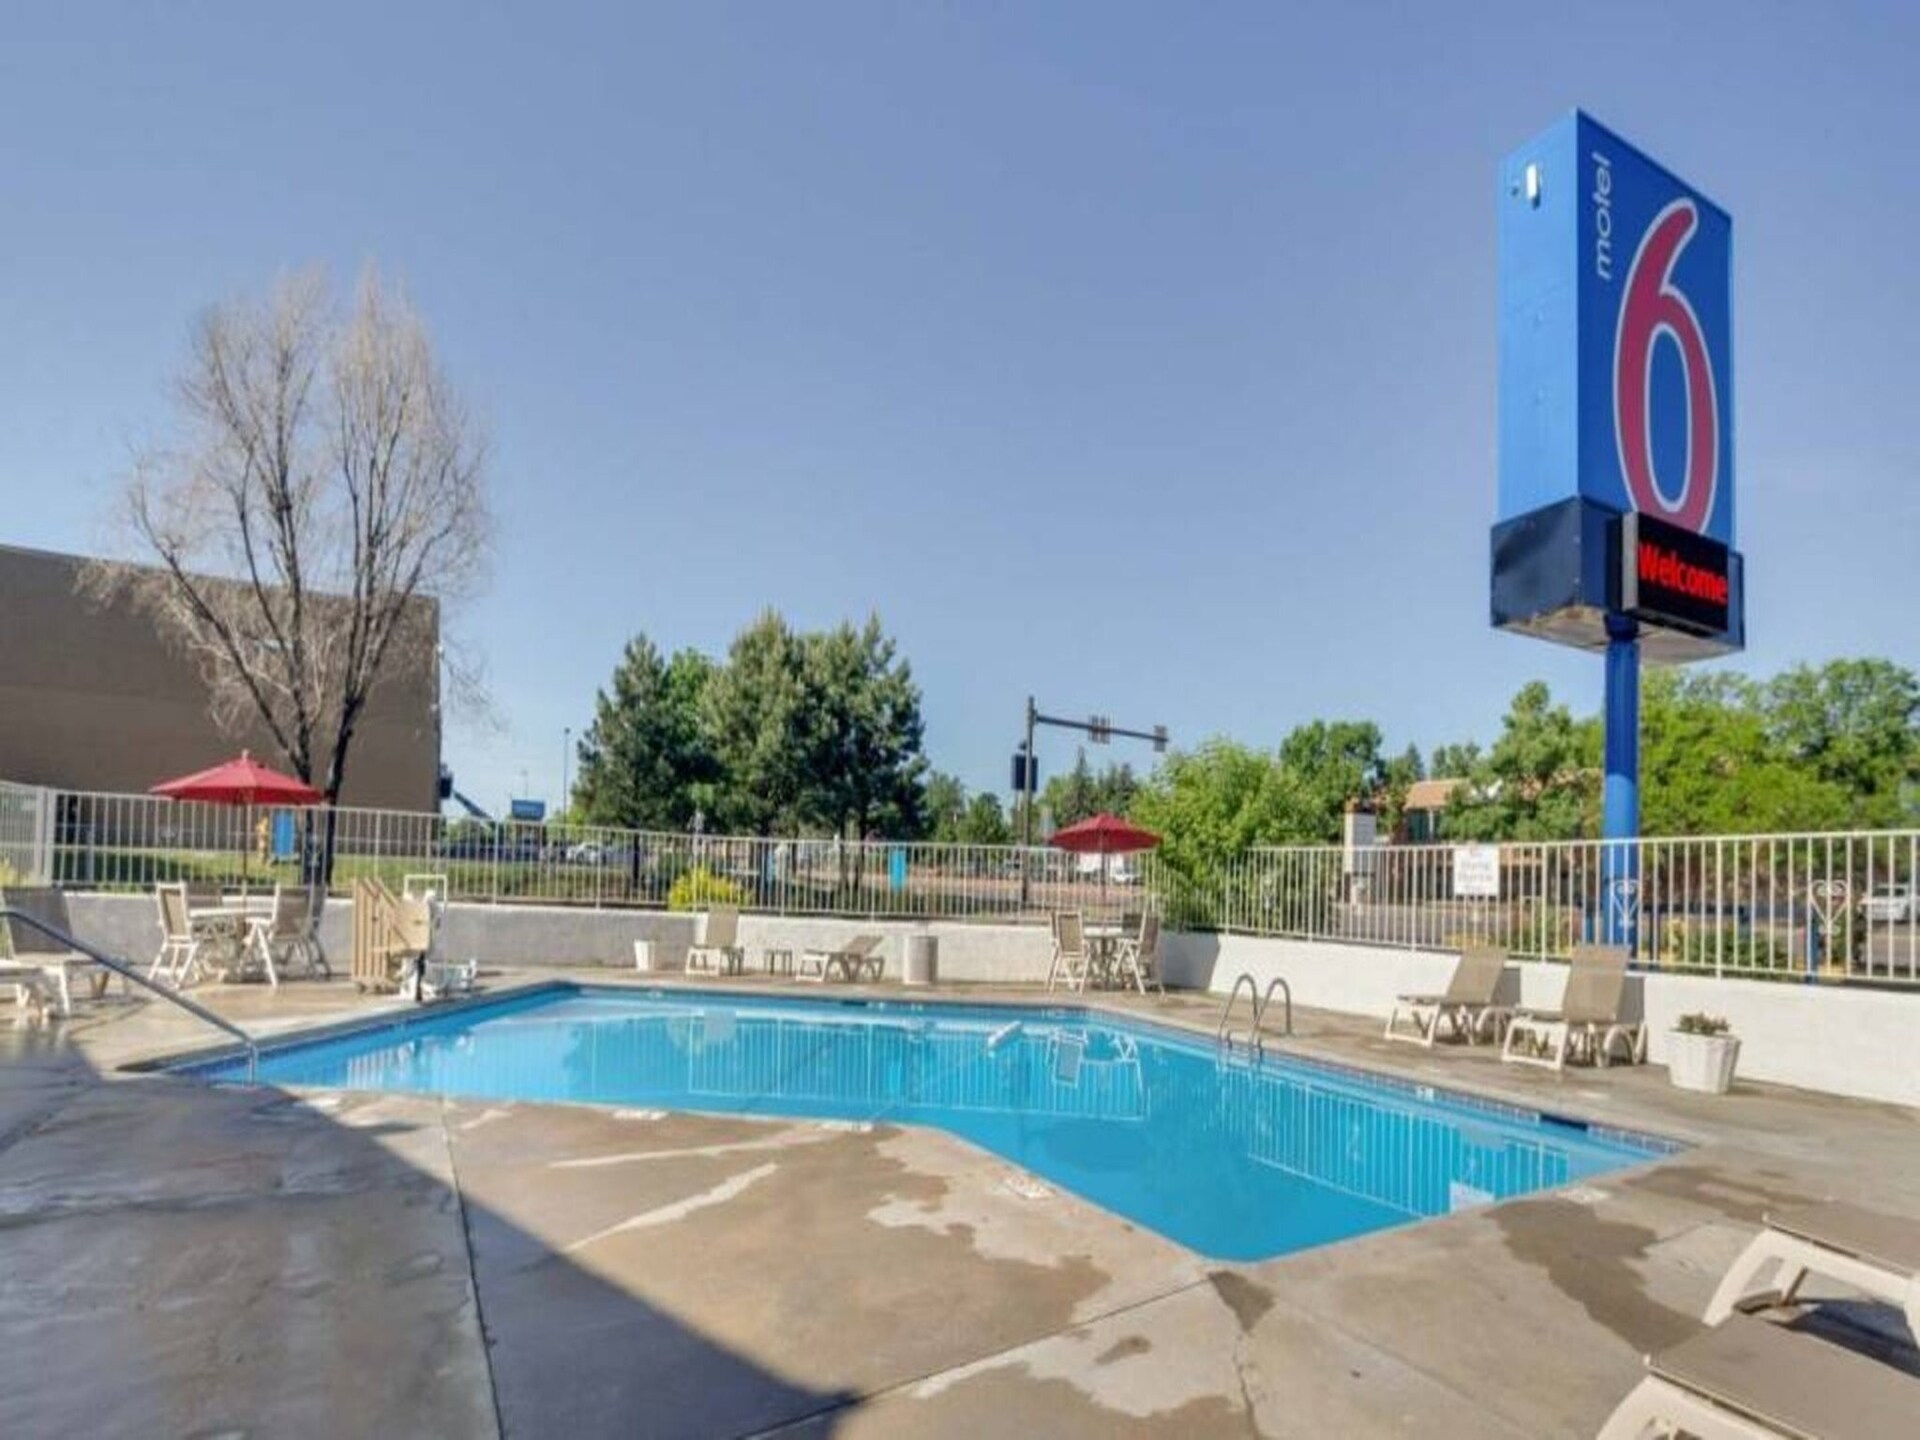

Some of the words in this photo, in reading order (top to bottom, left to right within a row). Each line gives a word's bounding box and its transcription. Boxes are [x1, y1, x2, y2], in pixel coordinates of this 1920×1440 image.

[1592, 152, 1611, 280] motel
[1613, 197, 1720, 535] 6
[1638, 541, 1728, 606] Welcome
